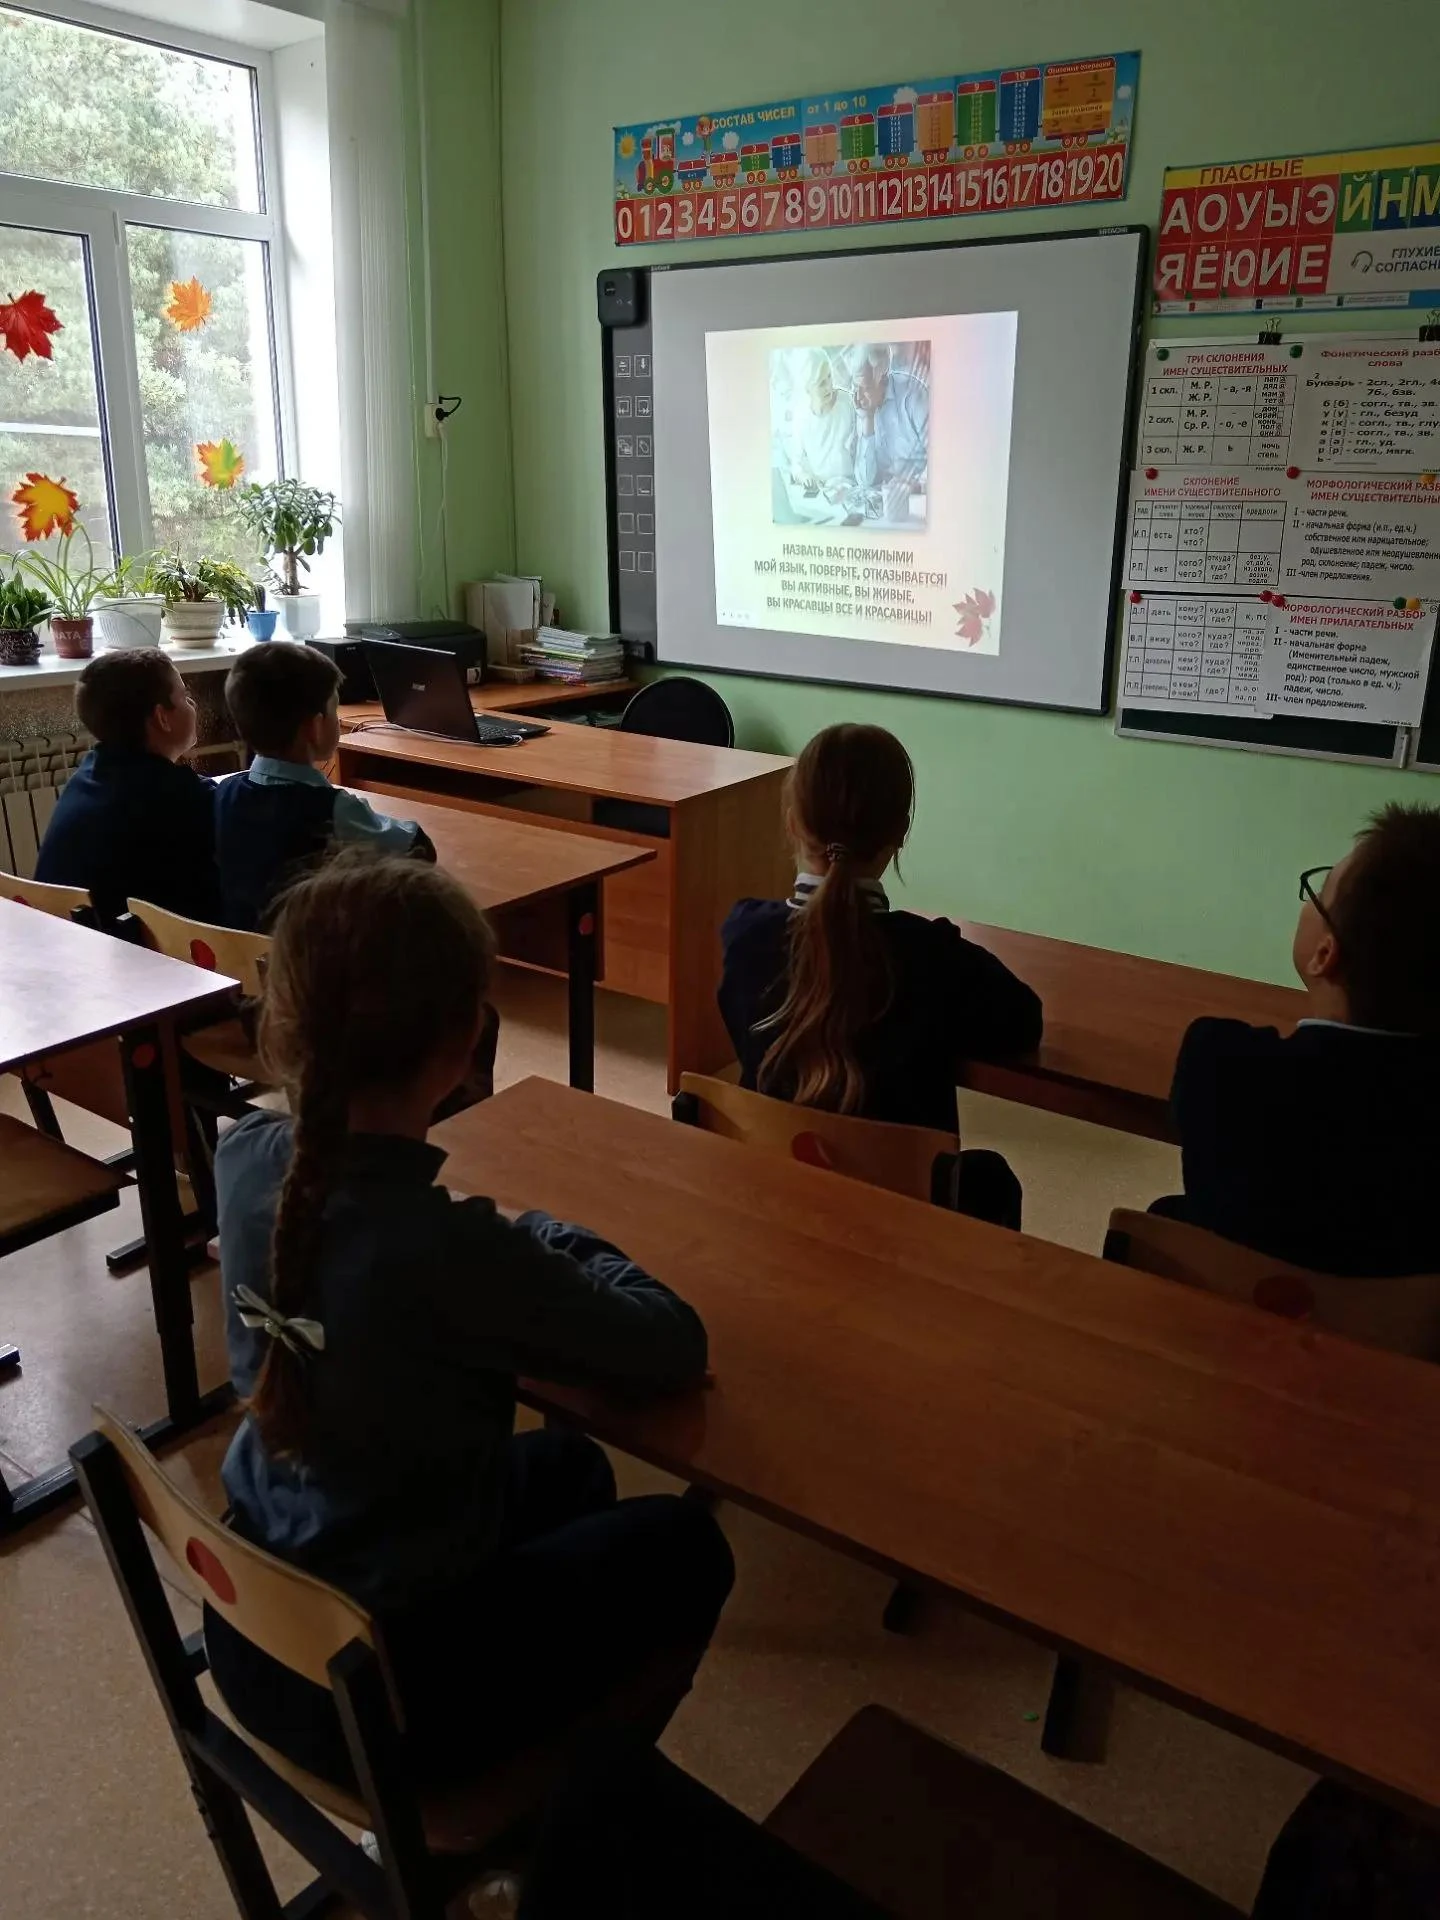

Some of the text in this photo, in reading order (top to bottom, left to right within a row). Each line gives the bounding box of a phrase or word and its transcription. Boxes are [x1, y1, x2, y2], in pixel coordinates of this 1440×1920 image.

[712, 95, 867, 129] СОСТАВ ЧИСЕЛ от 1 до 10
[1200, 158, 1304, 185] ГЛАСНЫЕ
[617, 151, 1122, 239] 0 1 2 3 4 5 6 7 8 9 10 11 12 13 14 15 16 17 18 19 20
[1186, 352, 1265, 364] ТРИ СКЛОНЕНИЯ
[1321, 349, 1409, 358] Фонетический
[1162, 364, 1288, 376] ИМЕН СУЩЕСТВИТЕЛЬНЫХ
[1183, 476, 1241, 486] СКЛОНЕНИЕ
[1306, 480, 1413, 491] МОРФОЛОГИЧЕСКИЙ
[1144, 488, 1281, 497] ИМЕНИ СУЩЕСТВИТЕЛЬНОГО
[1310, 492, 1339, 501] ИМЕН
[1304, 533, 1350, 543] собственное
[781, 543, 915, 565] НАЗВАТЬ ВАС ПОЖИЛЫМИ
[753, 559, 948, 587] МОЙ ЯЗЫК, ПОВЕРЬТЕ, ОТКАЗЫВАЕТСЯ!
[780, 579, 916, 605] ВЫ АКТИВНЫЕ, ВЫ ЖИВЫЕ,
[765, 596, 933, 624] ВЫ КРАСАВЦЫ ВСЕ И КРАСАВИЦЫ!
[1281, 604, 1426, 620] МОРФОЛОГИЧЕСКИЙ РАЗБОР
[1290, 615, 1414, 631] ИМЕН ПРИЛАГАТЕЛЬНЫХ
[1289, 640, 1335, 650] начальная
[1336, 641, 1367, 653] форма
[1288, 649, 1391, 666] (Именительный падеж,
[1286, 663, 1420, 680] единственное число, мужской
[1283, 683, 1315, 695] падеж,
[1309, 675, 1326, 685] род
[1327, 675, 1361, 687] (только
[1283, 695, 1368, 711] член предложения.
